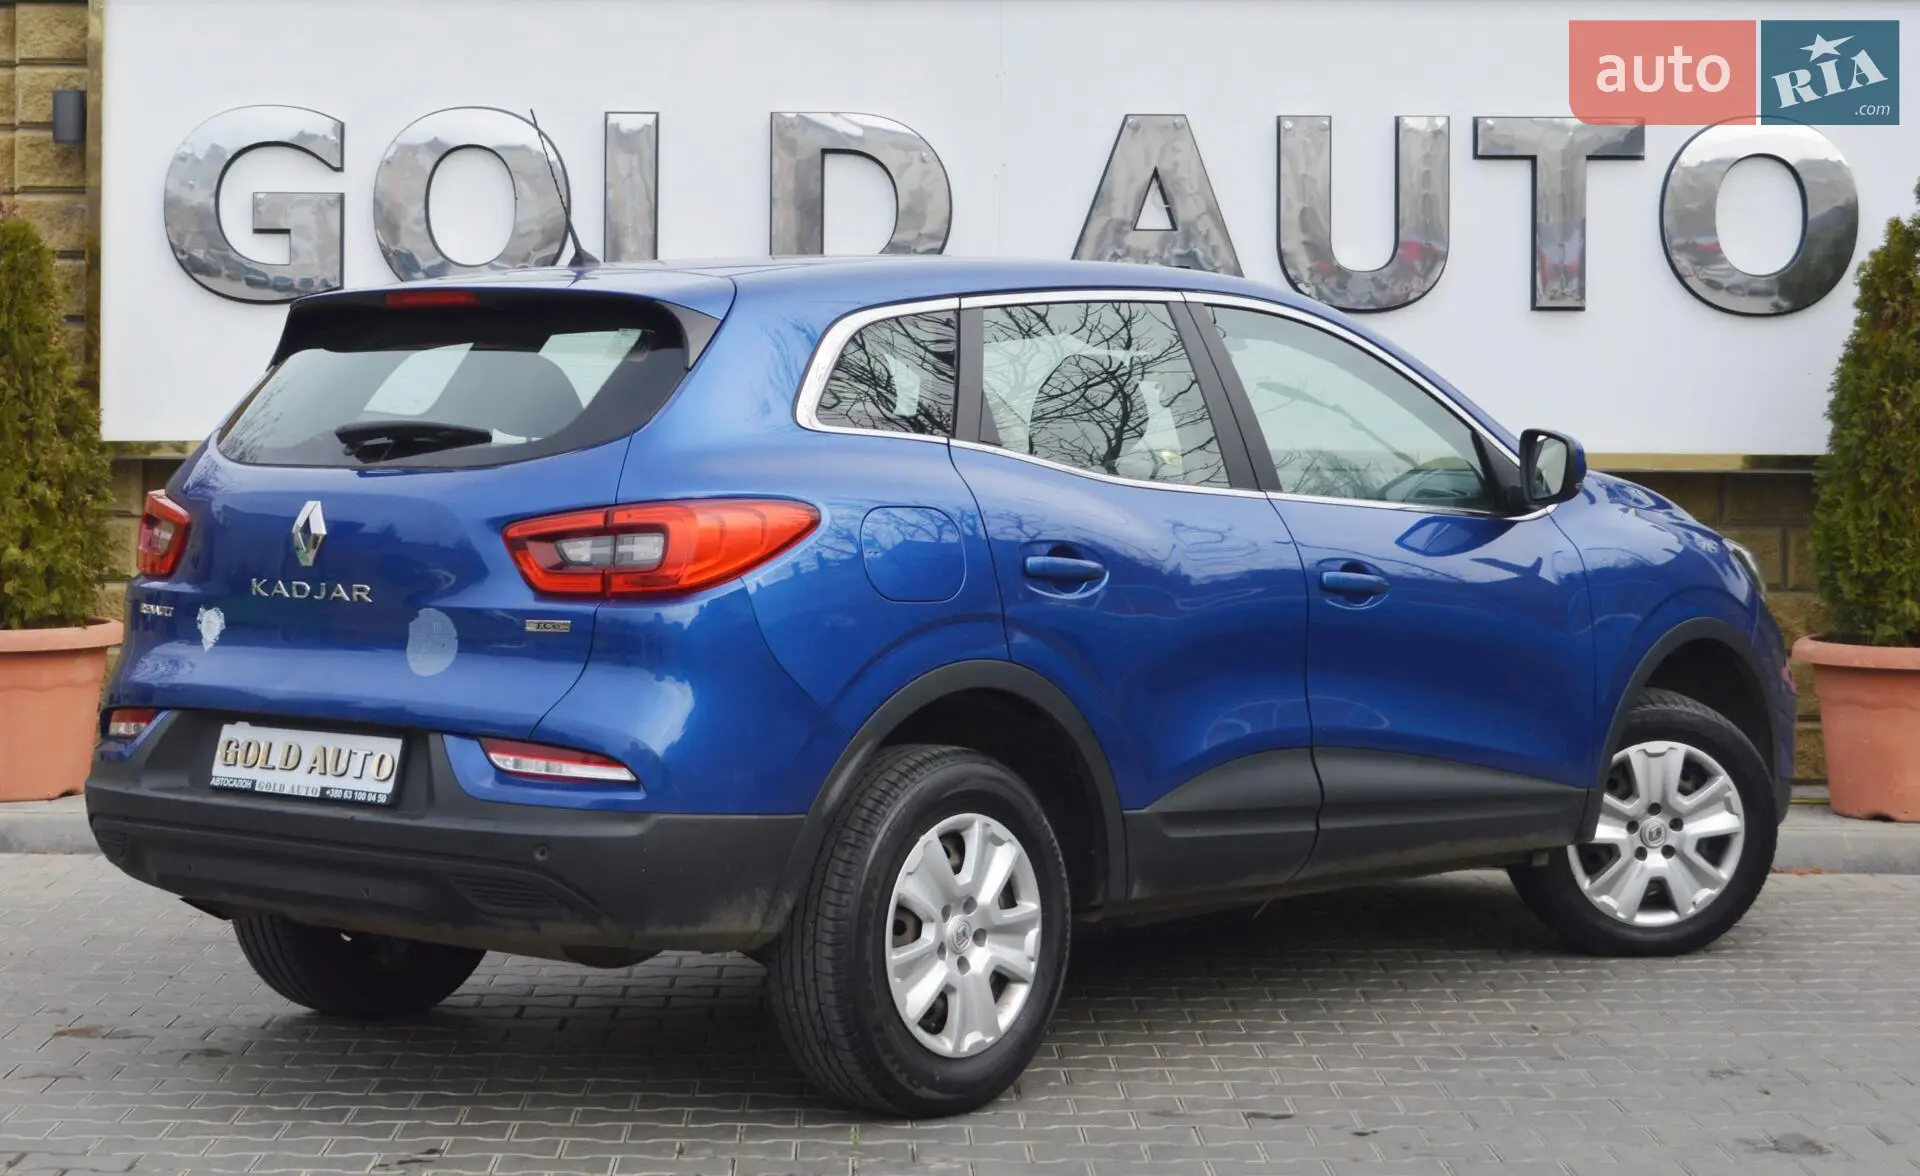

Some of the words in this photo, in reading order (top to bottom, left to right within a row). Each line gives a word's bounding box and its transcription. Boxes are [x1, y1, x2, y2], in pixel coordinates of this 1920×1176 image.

[164, 104, 953, 304] GOLD
[1071, 113, 1860, 317] AUTO
[251, 578, 374, 603] KADJAR
[219, 738, 302, 771] GOLD
[306, 745, 395, 782] AUTO
[210, 777, 252, 788] АВТОСАЛОН
[257, 782, 286, 792] GOLD
[288, 784, 318, 796] AUTO
[325, 789, 342, 798] +380
[354, 791, 366, 801] 100
